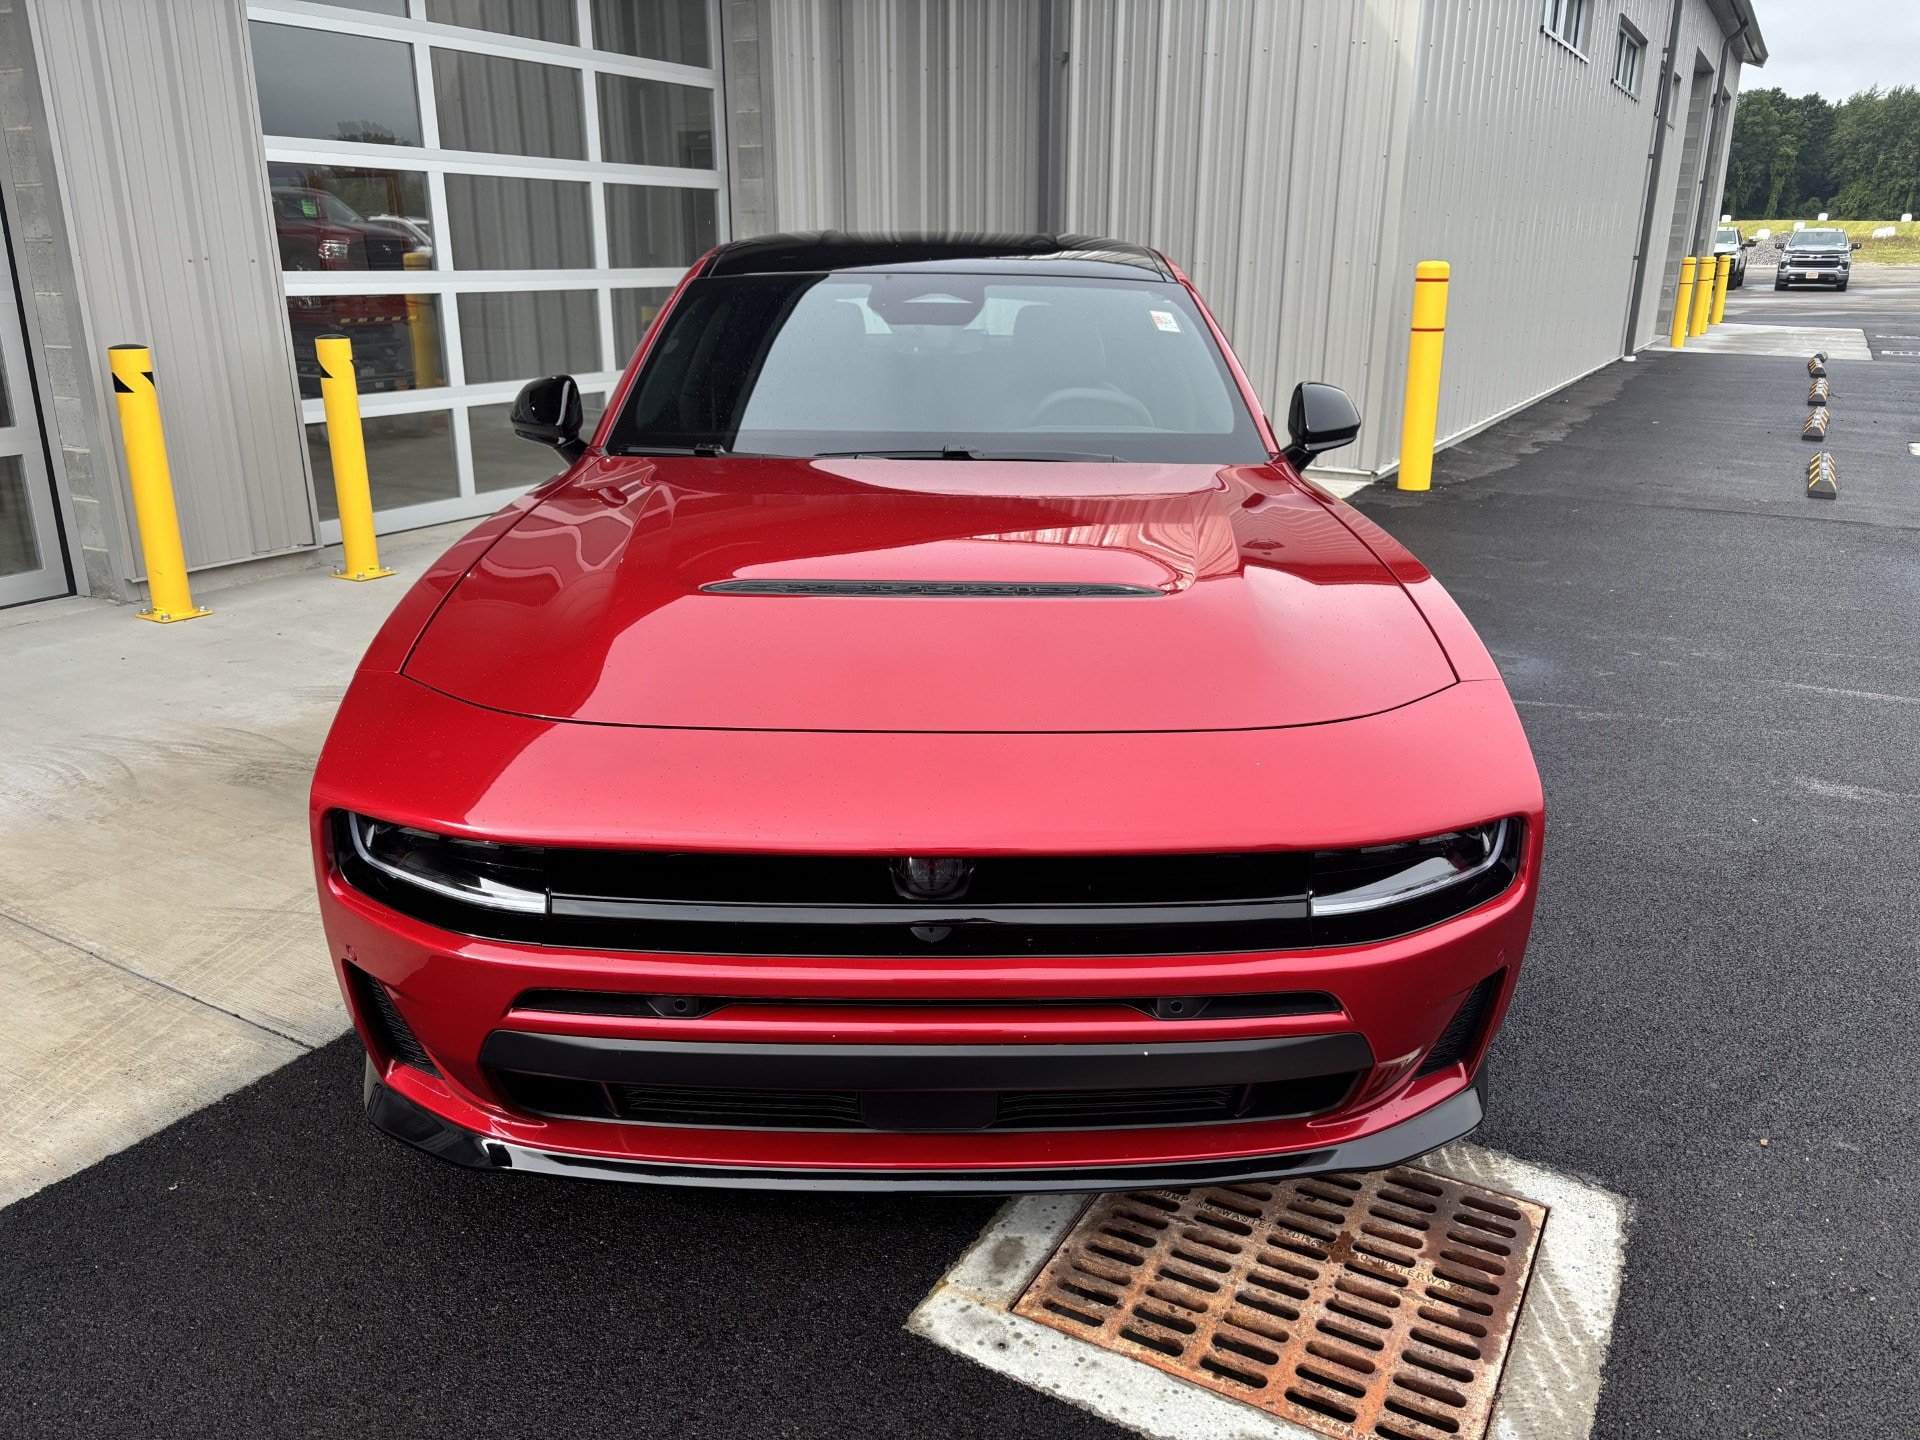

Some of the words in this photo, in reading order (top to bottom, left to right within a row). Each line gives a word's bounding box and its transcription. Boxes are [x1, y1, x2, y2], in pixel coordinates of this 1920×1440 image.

[1155, 1189, 1189, 1202] DUMP
[1196, 1201, 1213, 1211] NO
[1292, 1232, 1343, 1253] DRANS
[1378, 1260, 1465, 1293] WATERWAYS
